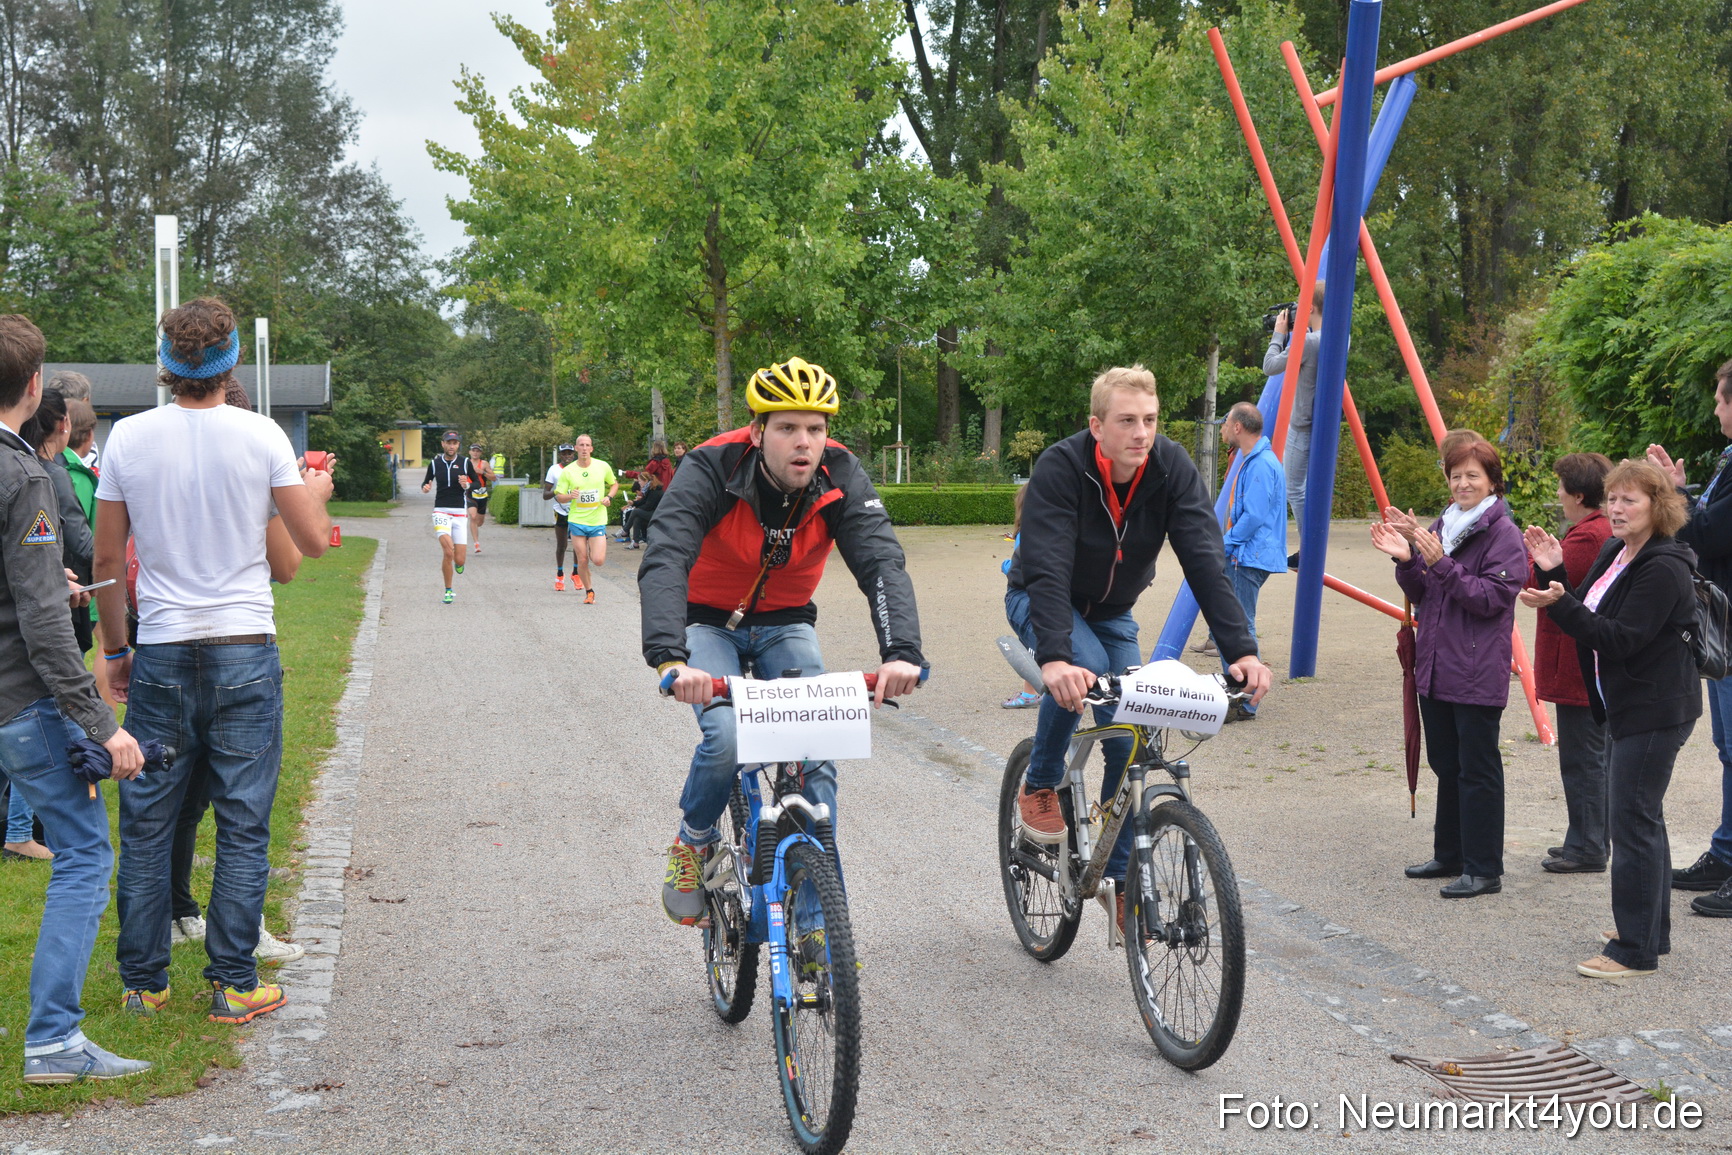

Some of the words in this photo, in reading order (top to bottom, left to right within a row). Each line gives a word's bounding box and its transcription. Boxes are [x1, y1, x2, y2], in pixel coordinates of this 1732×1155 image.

[580, 494, 596, 503] 635
[435, 517, 448, 526] 655
[746, 686, 800, 700] Erster
[806, 684, 857, 698] Mann
[1135, 681, 1175, 697] Erster
[1179, 686, 1215, 702] Mann
[739, 705, 868, 724] Halbmarathon
[1124, 700, 1217, 723] Halbmarathon
